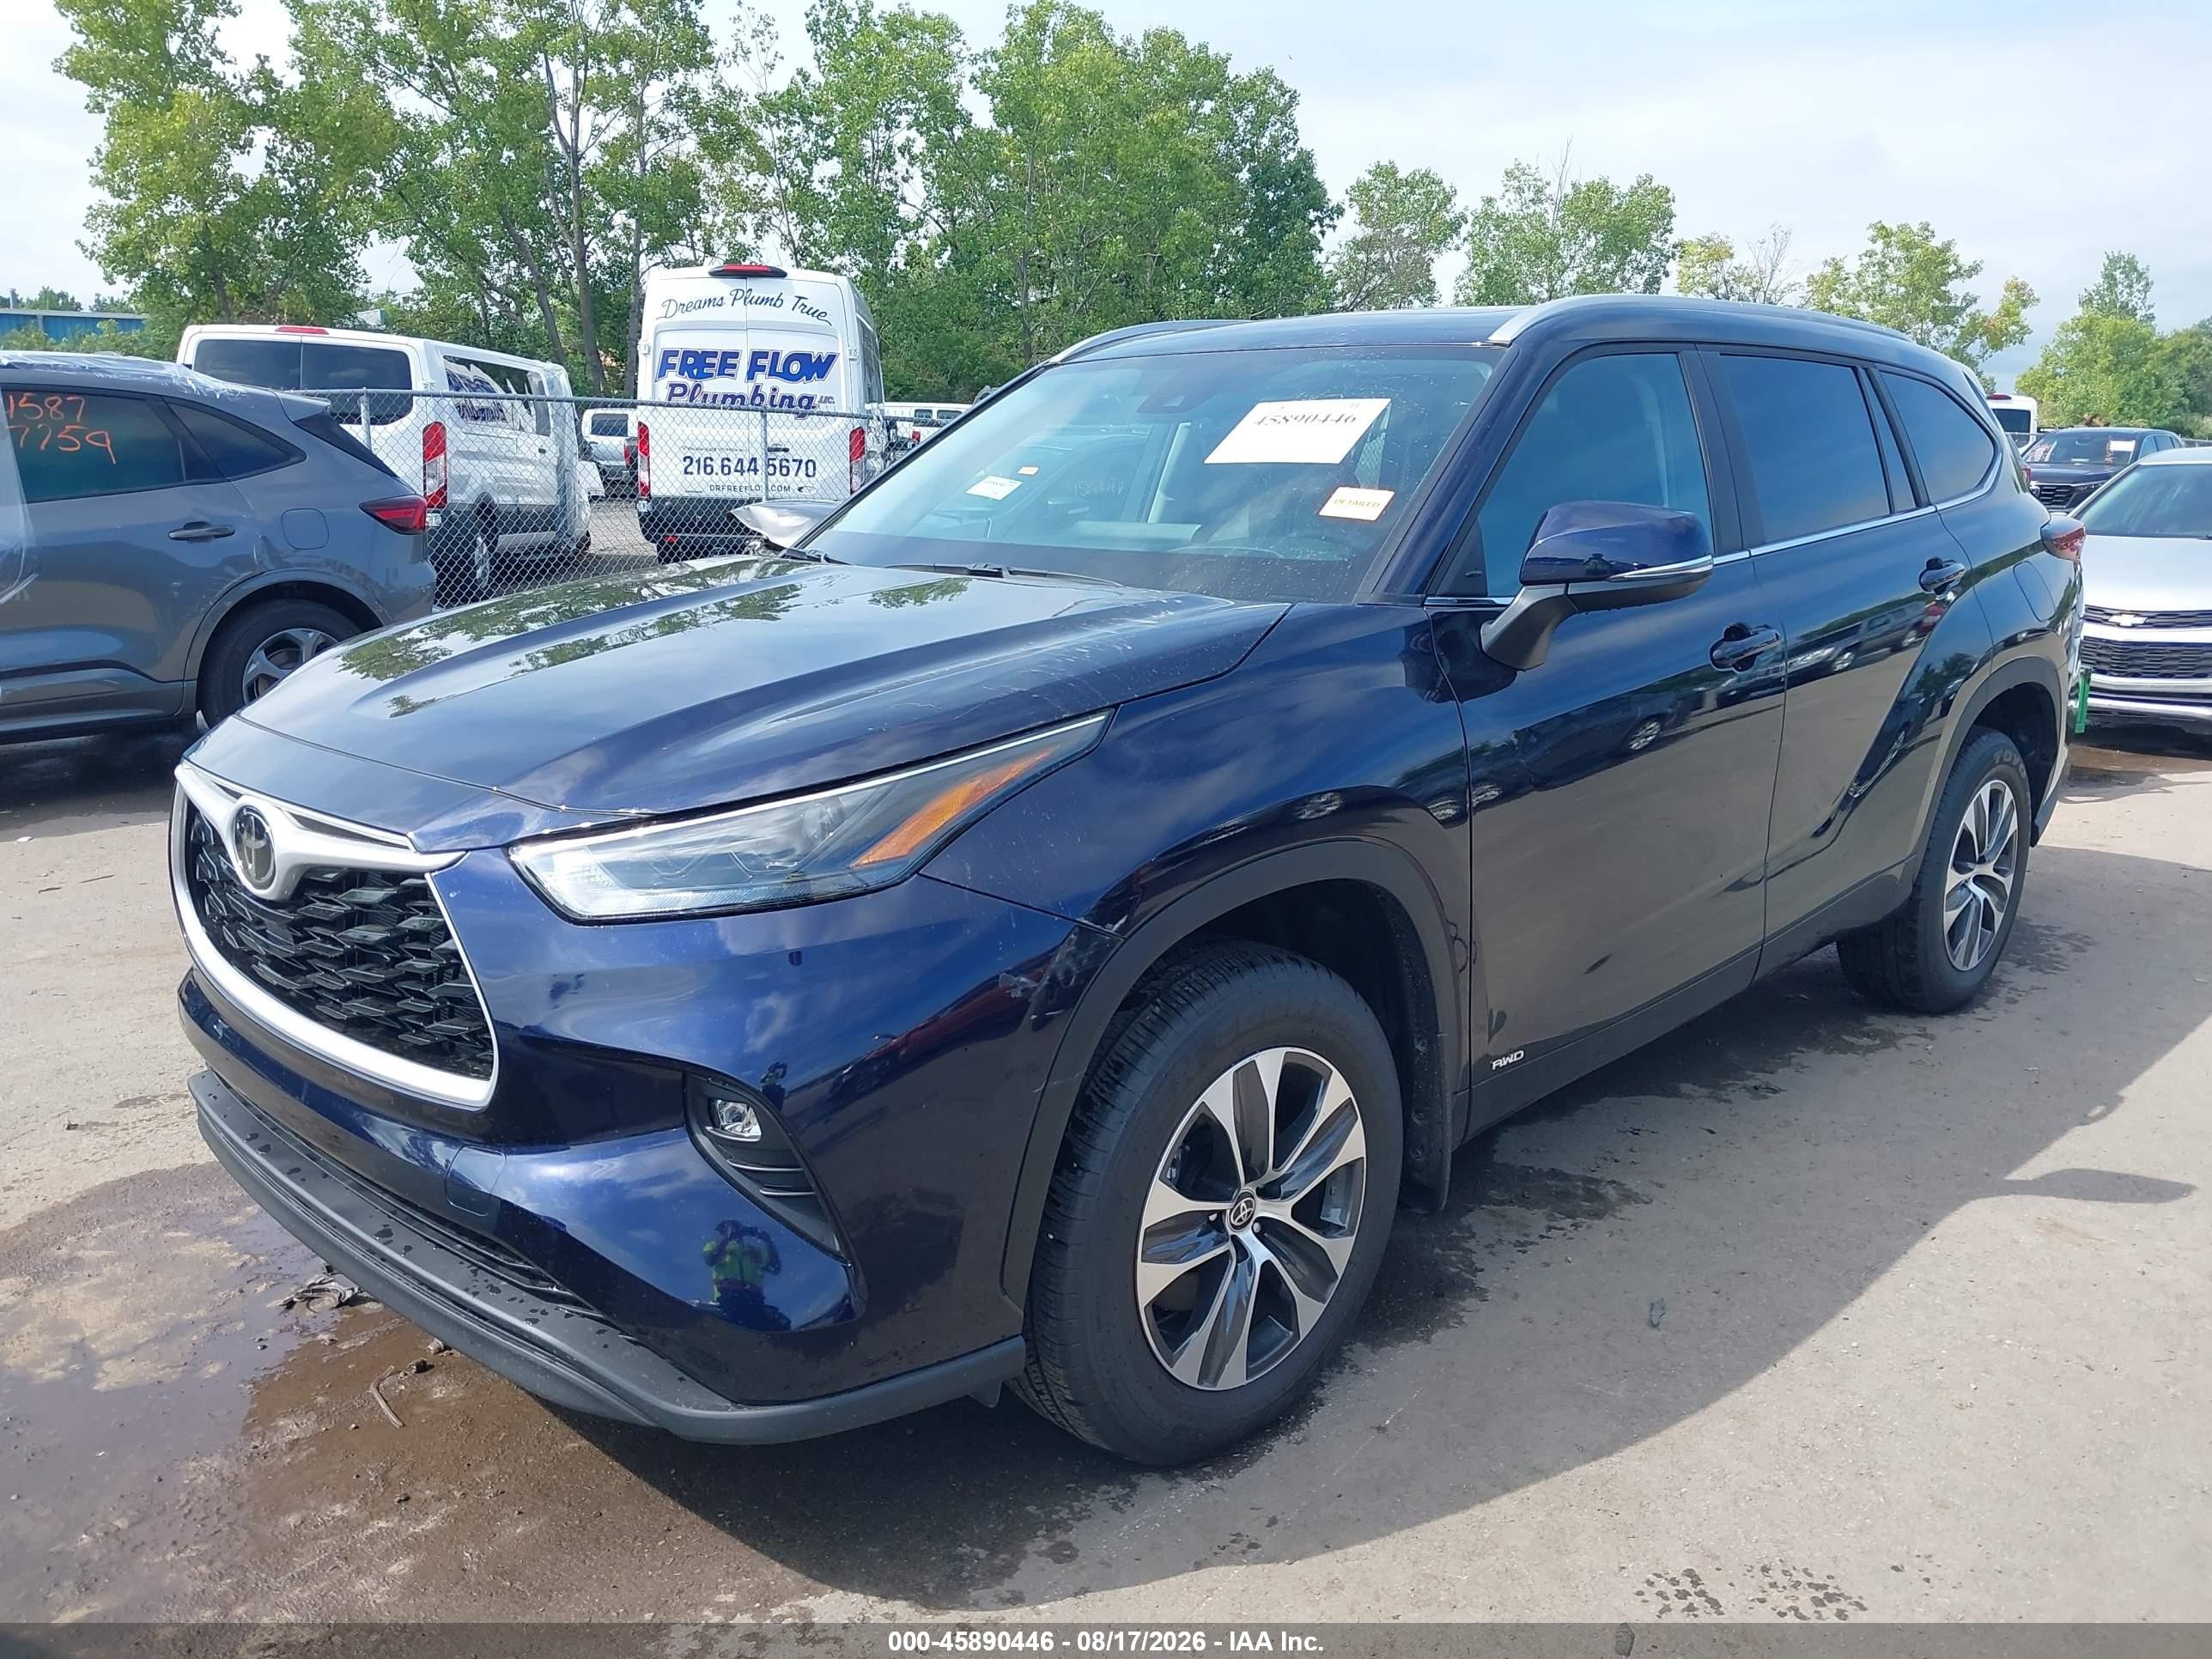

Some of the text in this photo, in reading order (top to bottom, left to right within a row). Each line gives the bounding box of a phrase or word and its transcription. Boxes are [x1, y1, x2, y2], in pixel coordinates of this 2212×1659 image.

[656, 288, 832, 326] Dreams Plumb True
[656, 348, 839, 383] FREE FLOW
[666, 381, 820, 420] Plumbing
[1492, 1050, 1525, 1071] AWD
